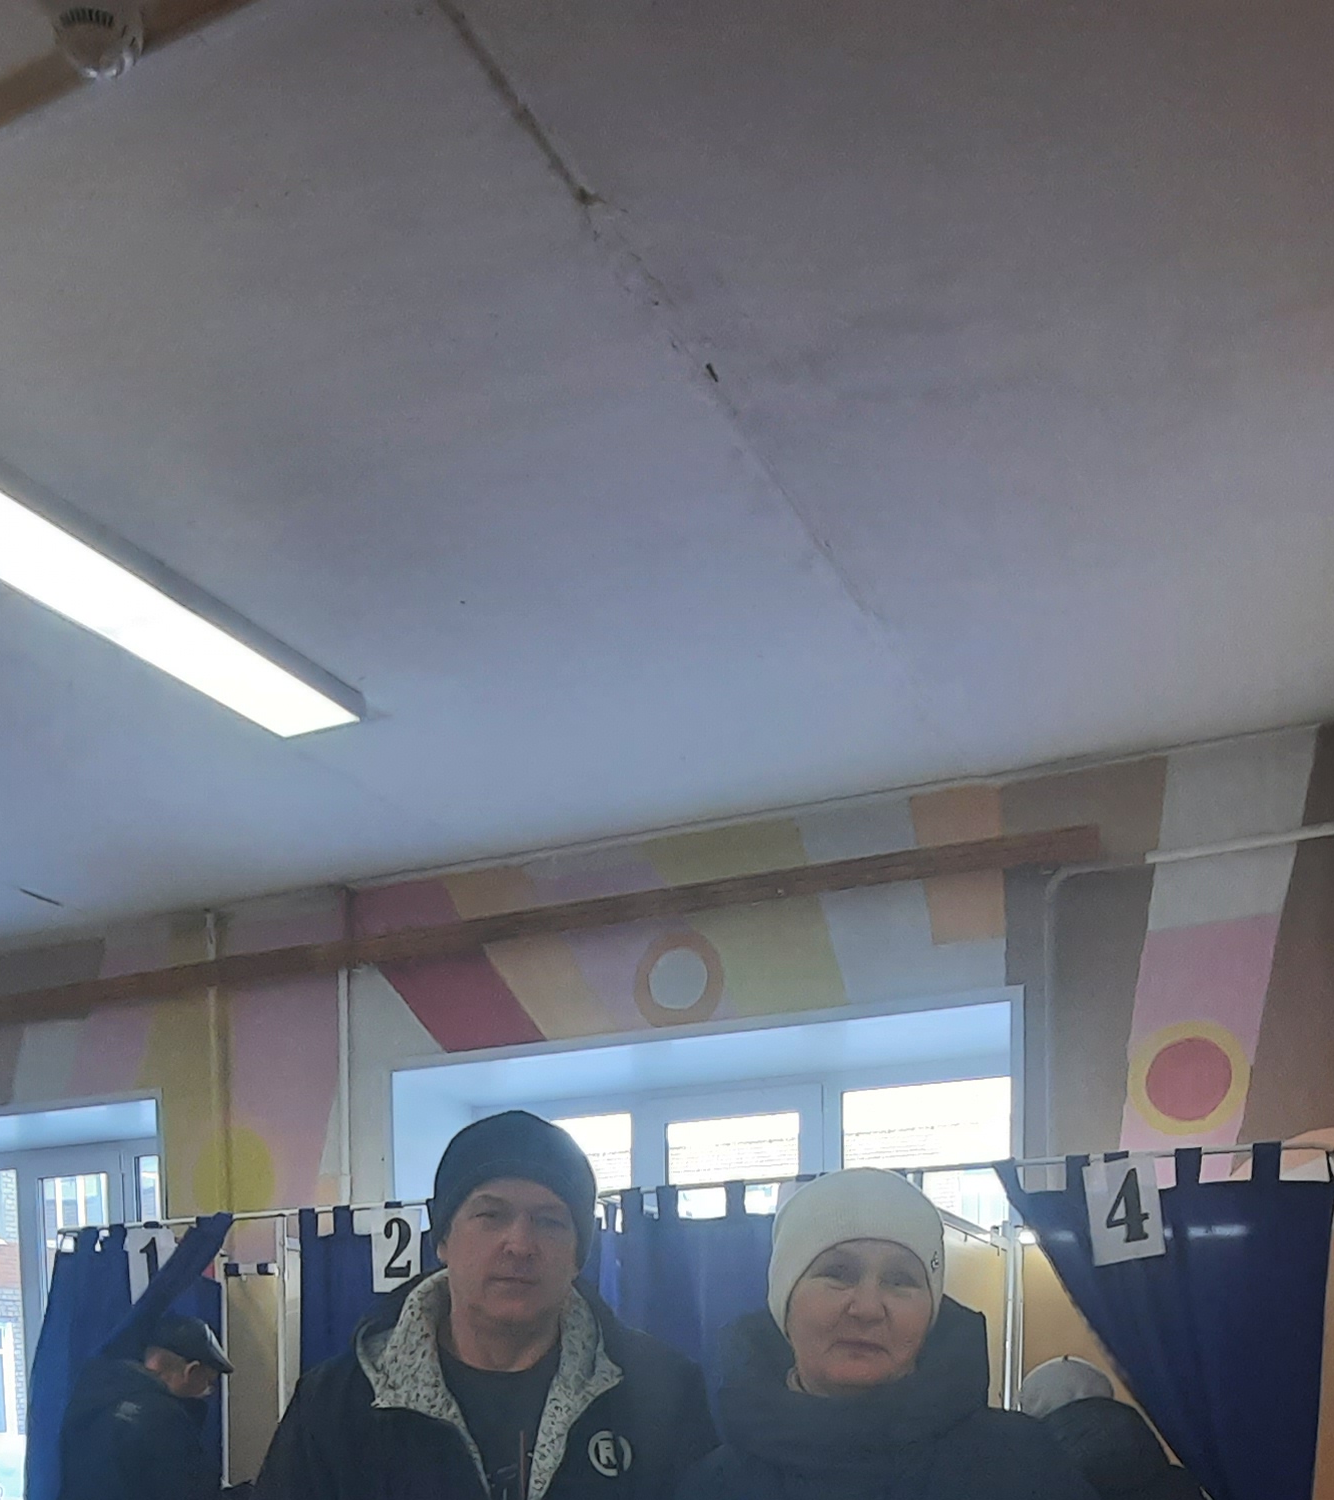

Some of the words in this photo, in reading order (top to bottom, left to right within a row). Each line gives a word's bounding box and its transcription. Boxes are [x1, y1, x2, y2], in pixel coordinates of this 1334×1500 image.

[1105, 1167, 1151, 1244] 4
[139, 1236, 161, 1283] 1
[382, 1215, 413, 1279] 2
